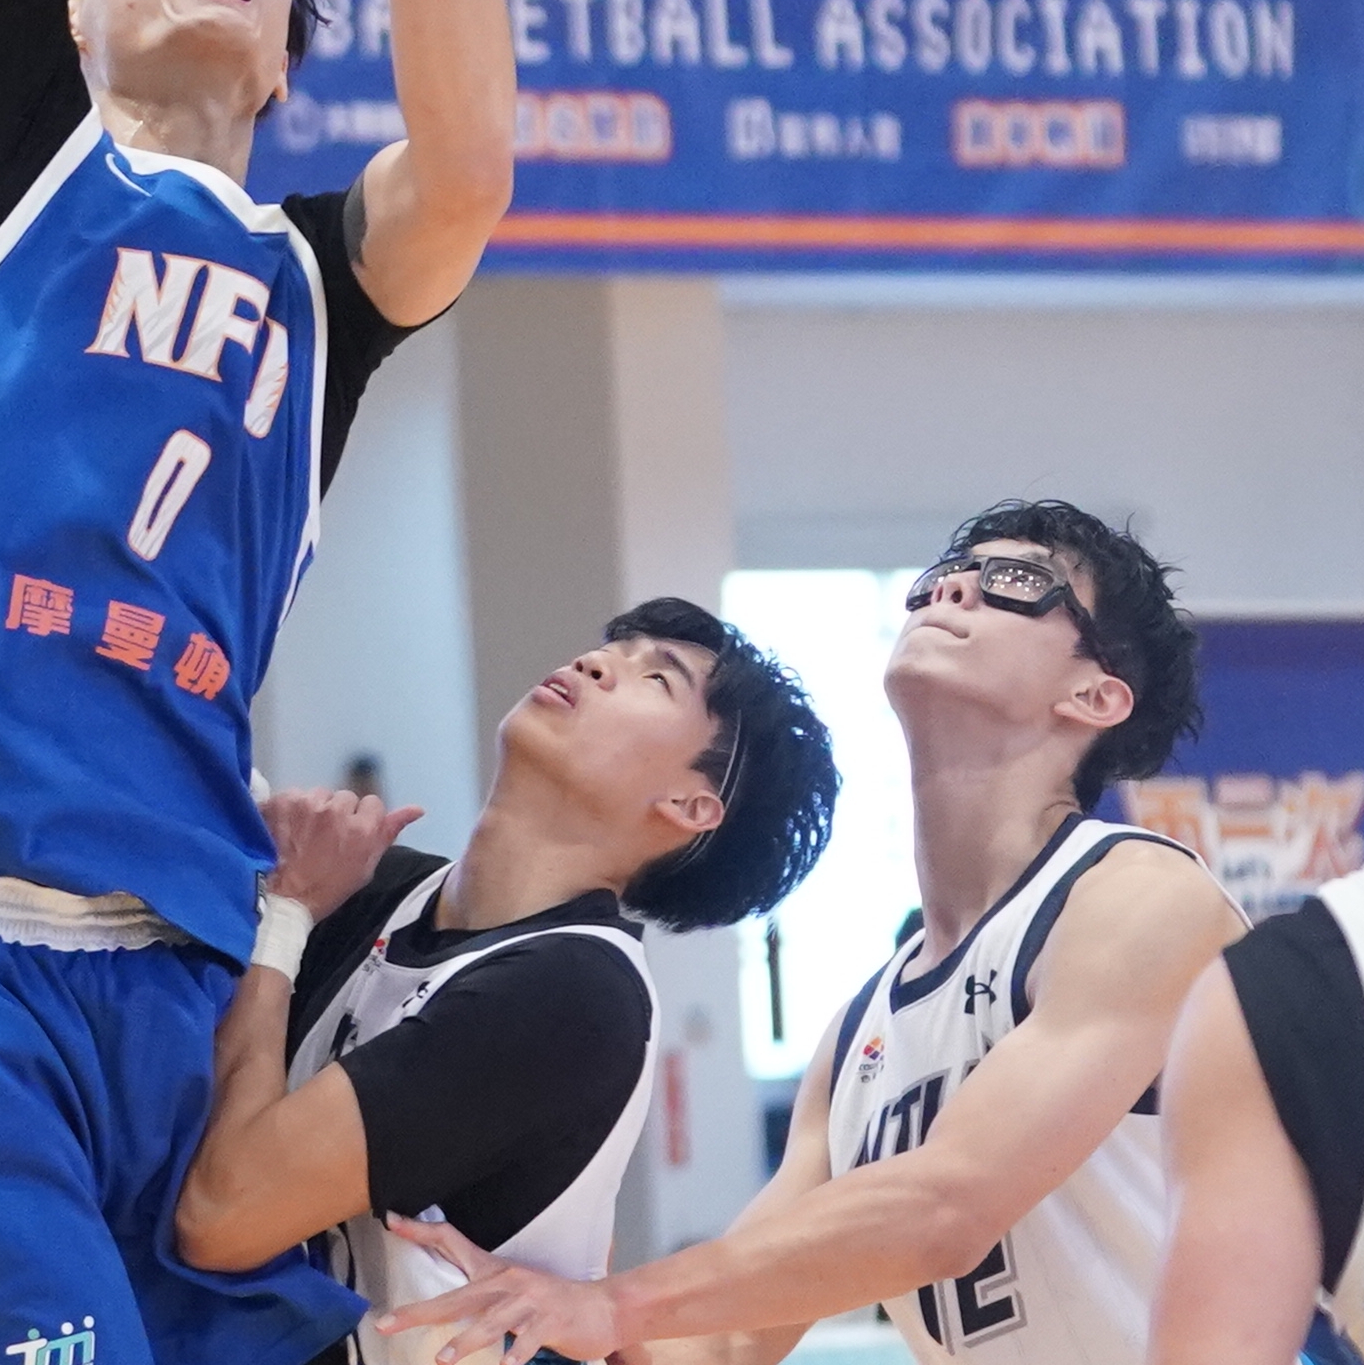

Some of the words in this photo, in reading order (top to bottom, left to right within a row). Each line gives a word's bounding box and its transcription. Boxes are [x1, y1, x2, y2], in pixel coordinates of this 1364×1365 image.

[127, 428, 212, 562] 0
[4, 572, 232, 702] 摩曼頓
